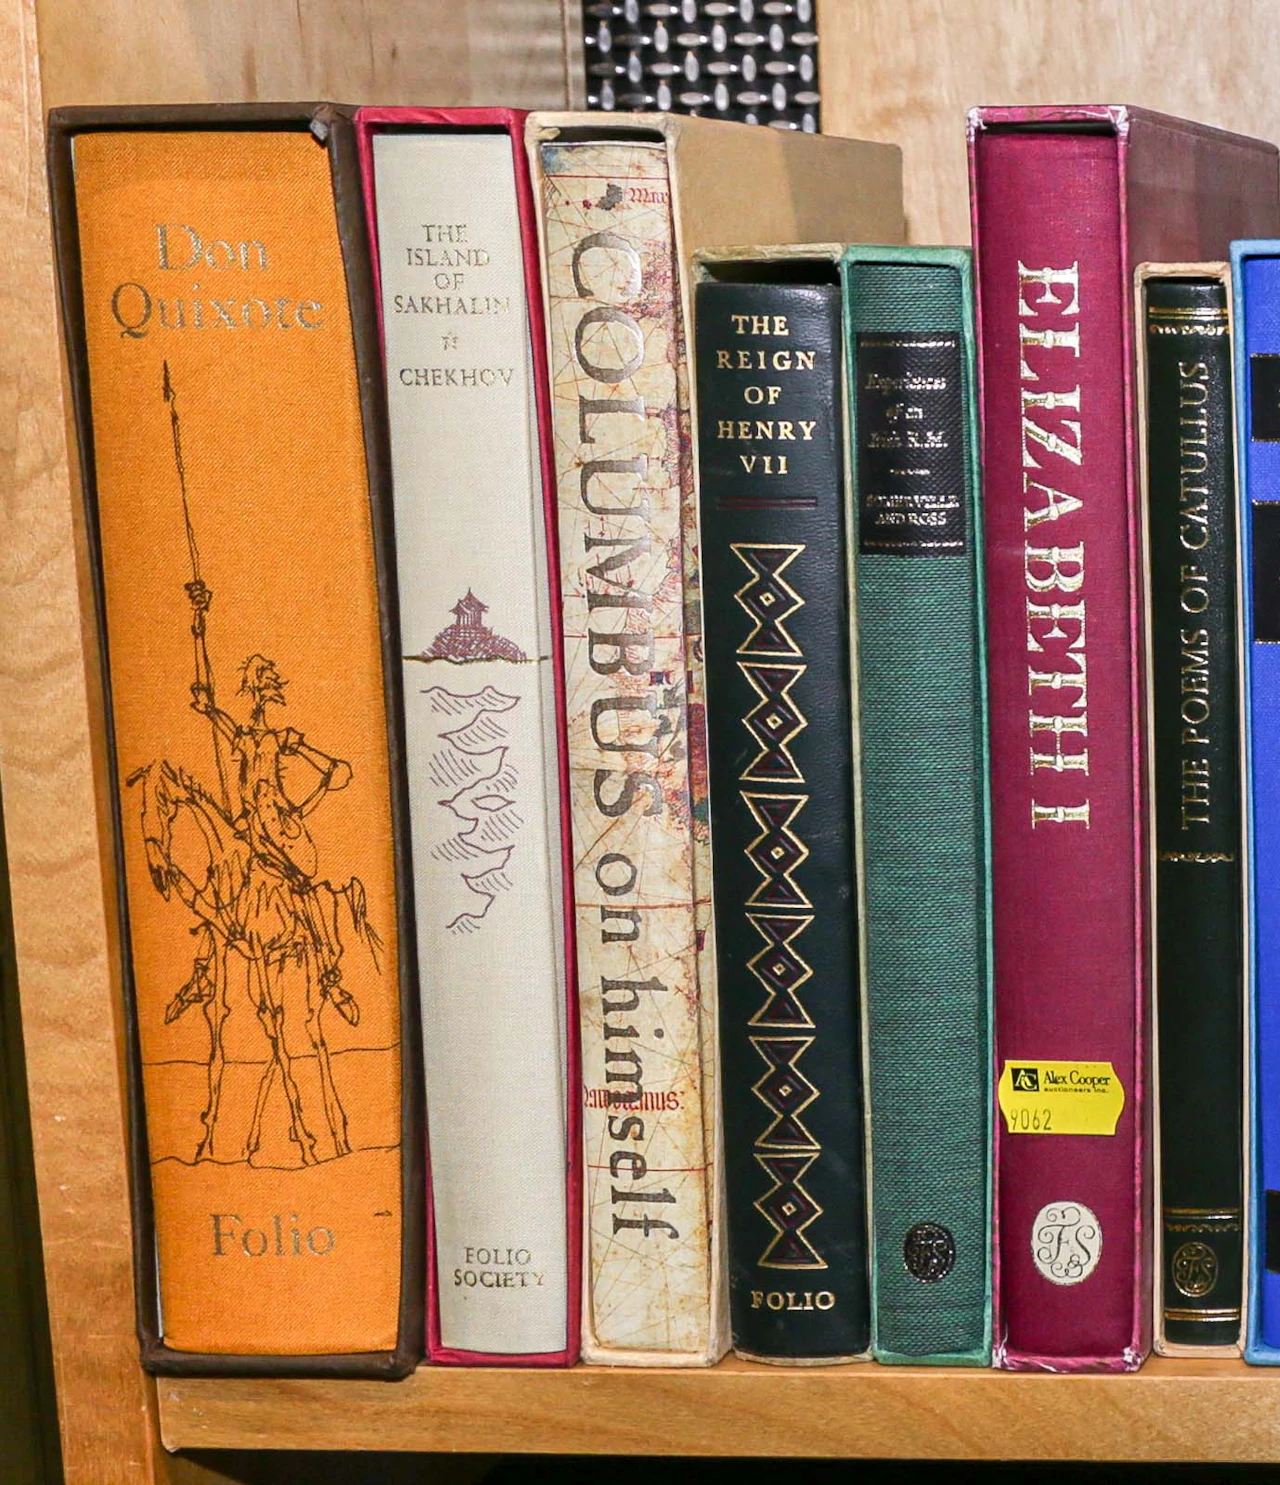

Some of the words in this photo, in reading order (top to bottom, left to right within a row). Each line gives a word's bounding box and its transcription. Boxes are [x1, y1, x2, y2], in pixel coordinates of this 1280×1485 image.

[422, 224, 469, 243] THE
[154, 223, 267, 272] Don
[405, 247, 491, 267] ISLAND
[434, 272, 465, 291] OF
[111, 281, 324, 339] Quixote
[394, 294, 511, 316] SAKHALIN
[731, 313, 790, 336] THE
[716, 349, 817, 371] REIGN
[399, 367, 515, 387] CHEKHOV
[743, 384, 782, 406] OF
[716, 419, 817, 442] HENRY
[739, 453, 789, 476] VII
[1178, 361, 1209, 551] CATULLUS
[573, 232, 662, 819] COLUMBUS
[1015, 259, 1088, 776] ELIZABETH
[1180, 562, 1209, 614] OF
[1180, 628, 1210, 752] POEMS
[1182, 760, 1210, 830] THE
[1031, 797, 1091, 830] I
[595, 852, 641, 944] on
[1044, 1070, 1067, 1085] Alex
[1069, 1069, 1111, 1088] Cooper
[600, 975, 680, 1241] himself
[209, 1213, 336, 1259] Folio
[464, 1247, 532, 1267] FOLIO
[453, 1269, 545, 1289] SOCIETY
[751, 1290, 836, 1311] FOLIO
